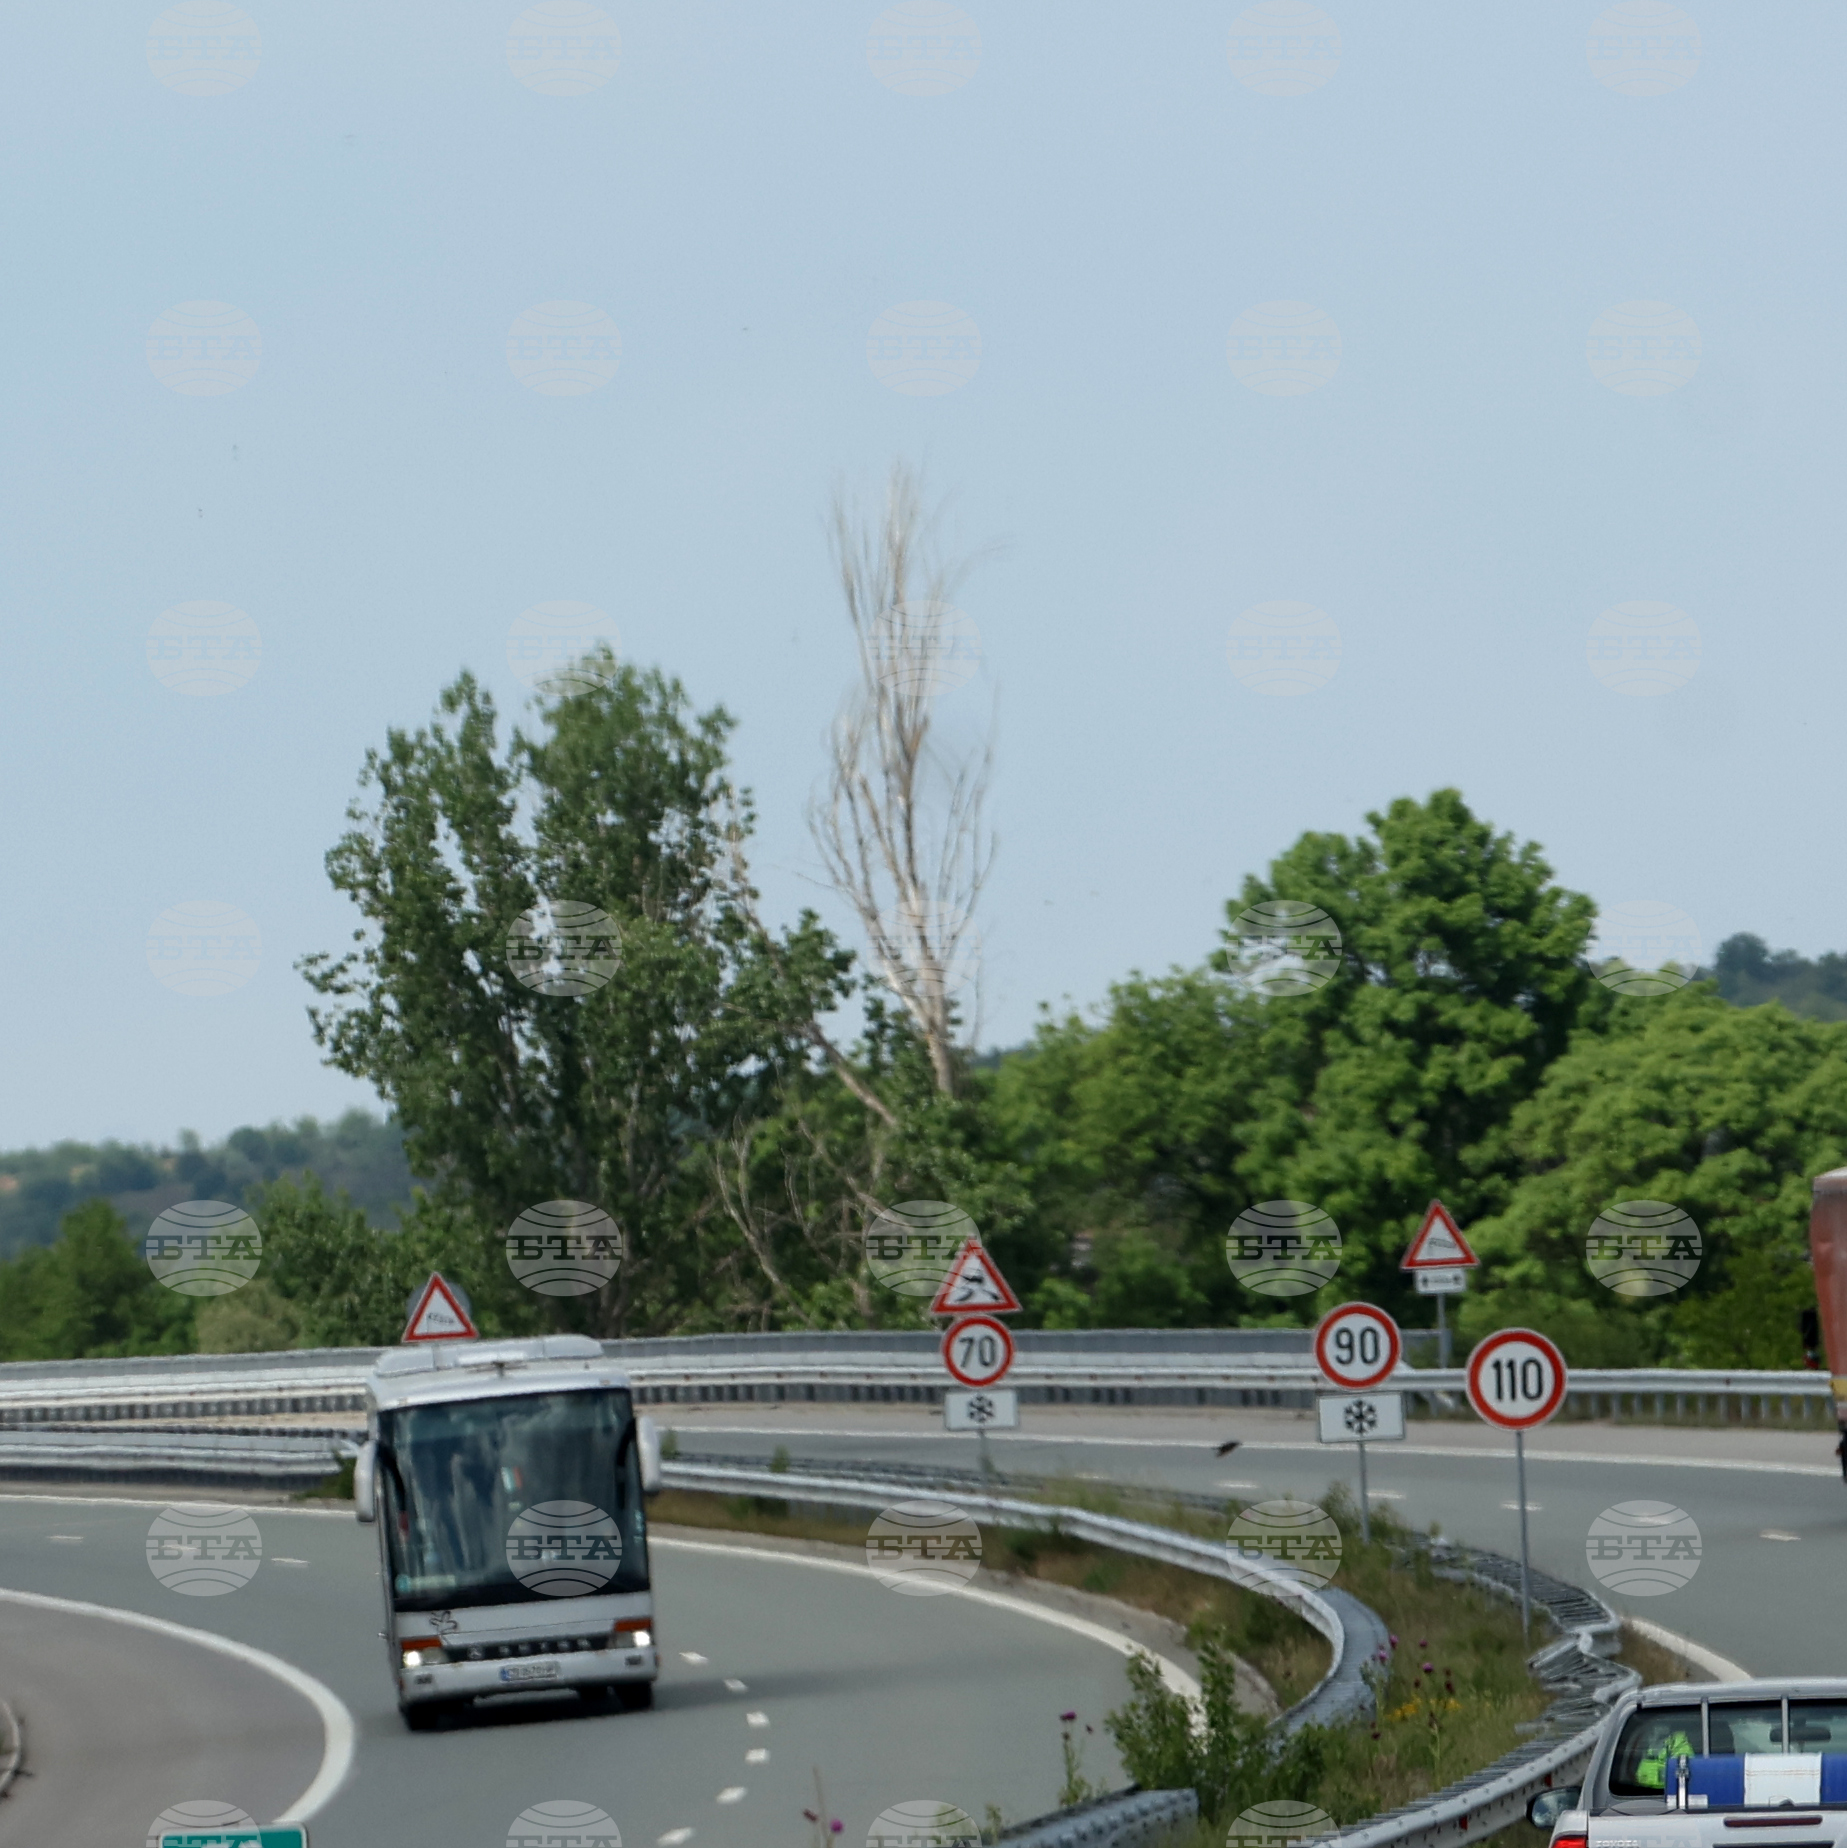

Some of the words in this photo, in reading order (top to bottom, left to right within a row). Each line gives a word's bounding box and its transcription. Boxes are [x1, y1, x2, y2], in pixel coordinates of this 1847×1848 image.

[959, 1335, 995, 1368] 70
[1335, 1326, 1380, 1365] 90
[1492, 1357, 1543, 1401] 110
